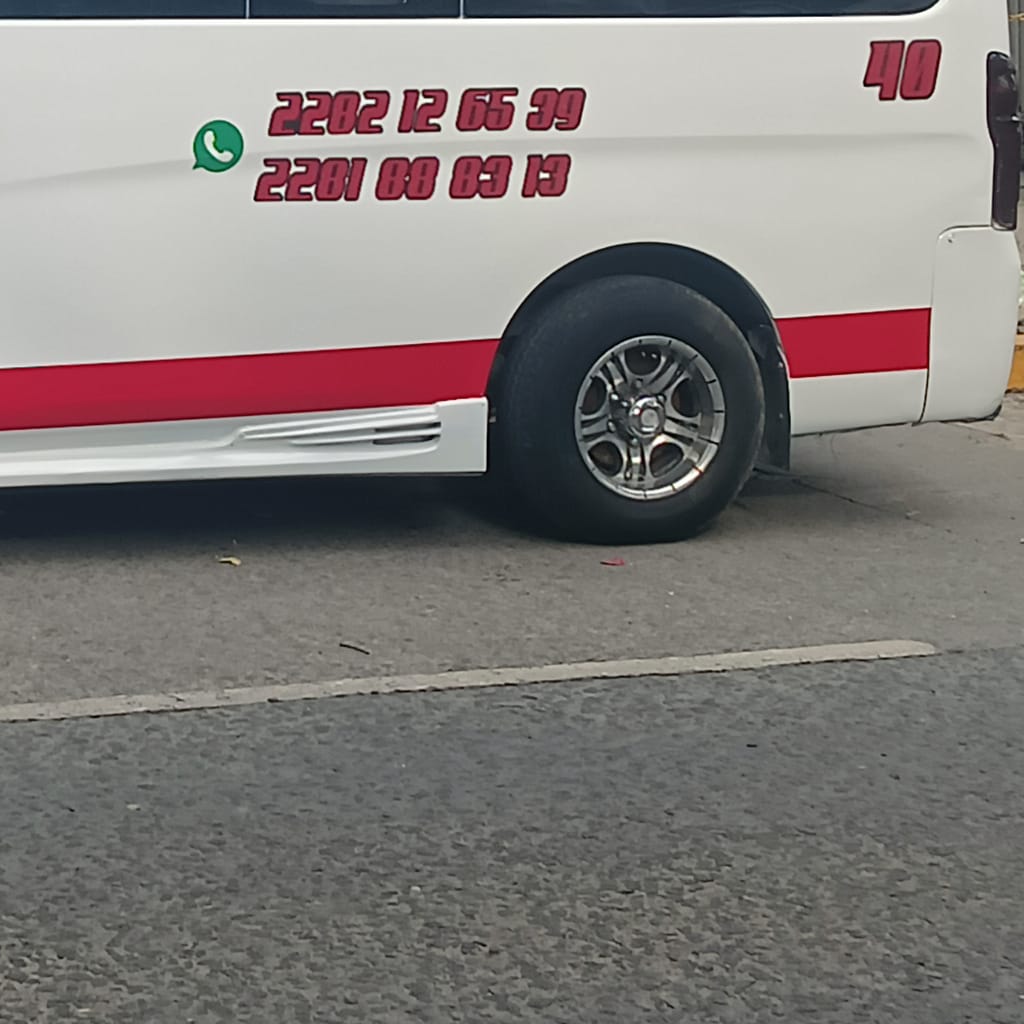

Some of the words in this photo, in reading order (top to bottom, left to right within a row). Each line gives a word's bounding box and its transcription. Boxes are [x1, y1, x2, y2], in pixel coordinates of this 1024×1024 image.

[863, 39, 942, 101] 40
[268, 90, 391, 136] 2282
[397, 89, 448, 133] 12
[455, 87, 519, 132] 65
[525, 87, 587, 131] 39
[253, 157, 368, 202] 2281
[375, 156, 440, 201] 88
[448, 155, 513, 199] 83
[521, 153, 572, 198] 13
